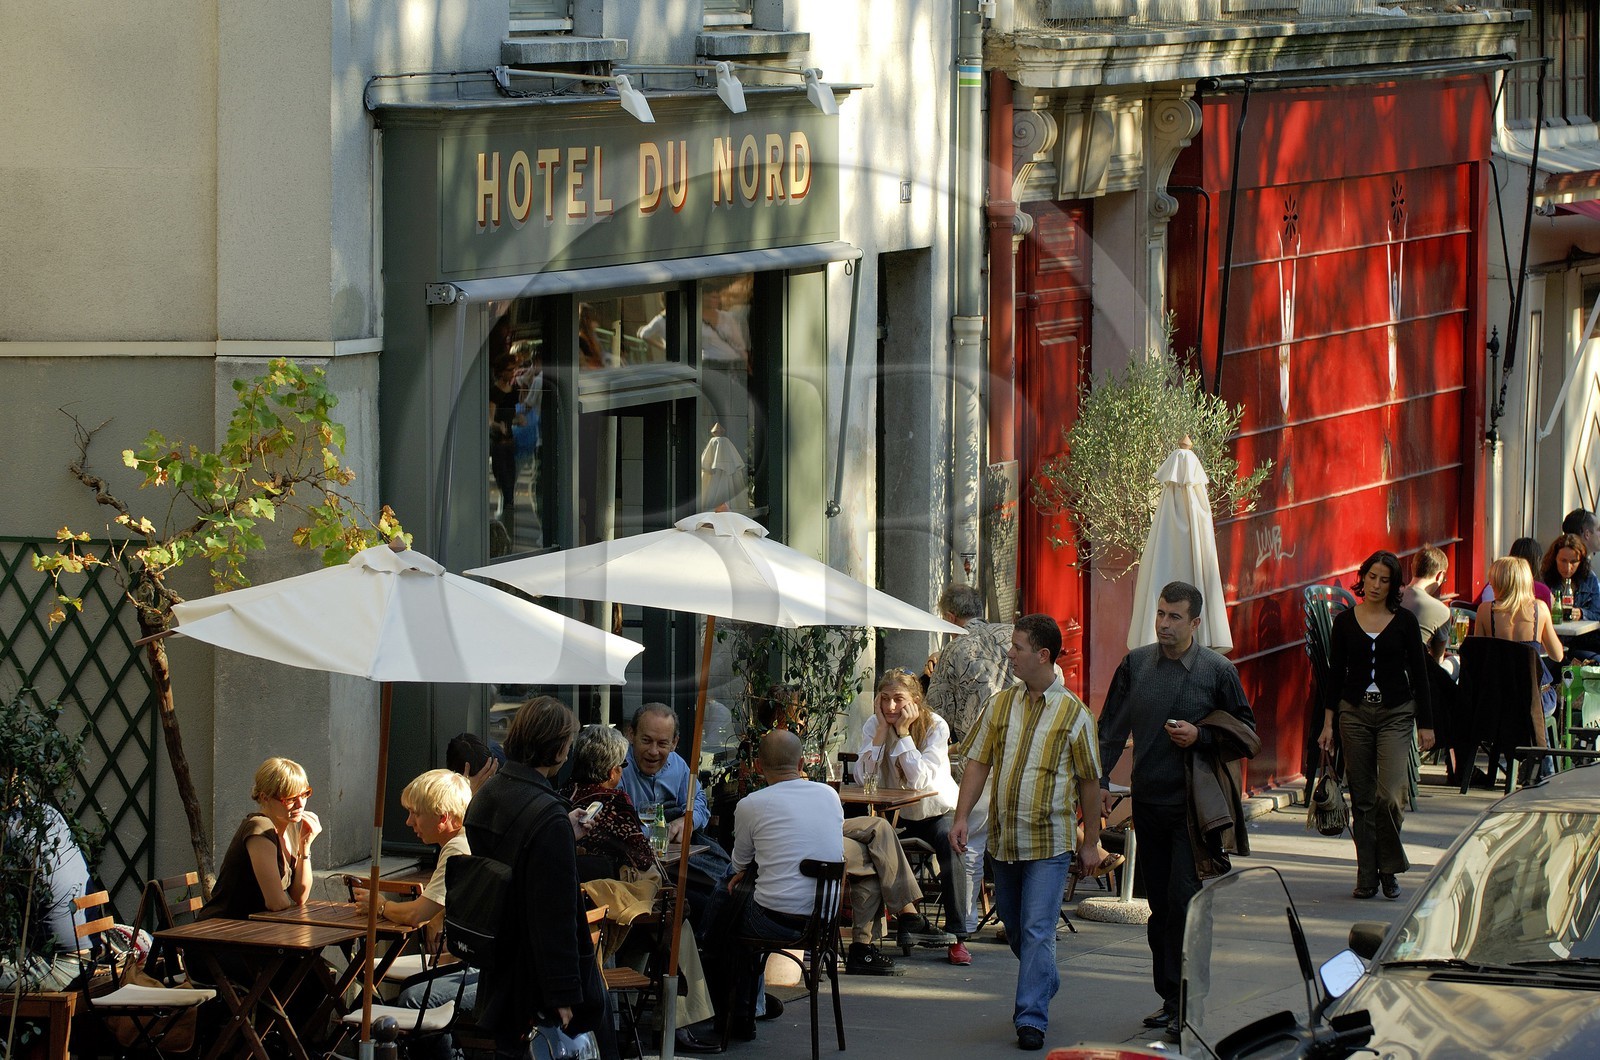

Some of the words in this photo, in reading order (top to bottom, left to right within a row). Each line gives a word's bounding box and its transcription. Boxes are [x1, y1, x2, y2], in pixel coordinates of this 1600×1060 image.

[476, 146, 614, 230] HOTEL
[639, 140, 689, 215] DU
[712, 131, 812, 206] NORD
